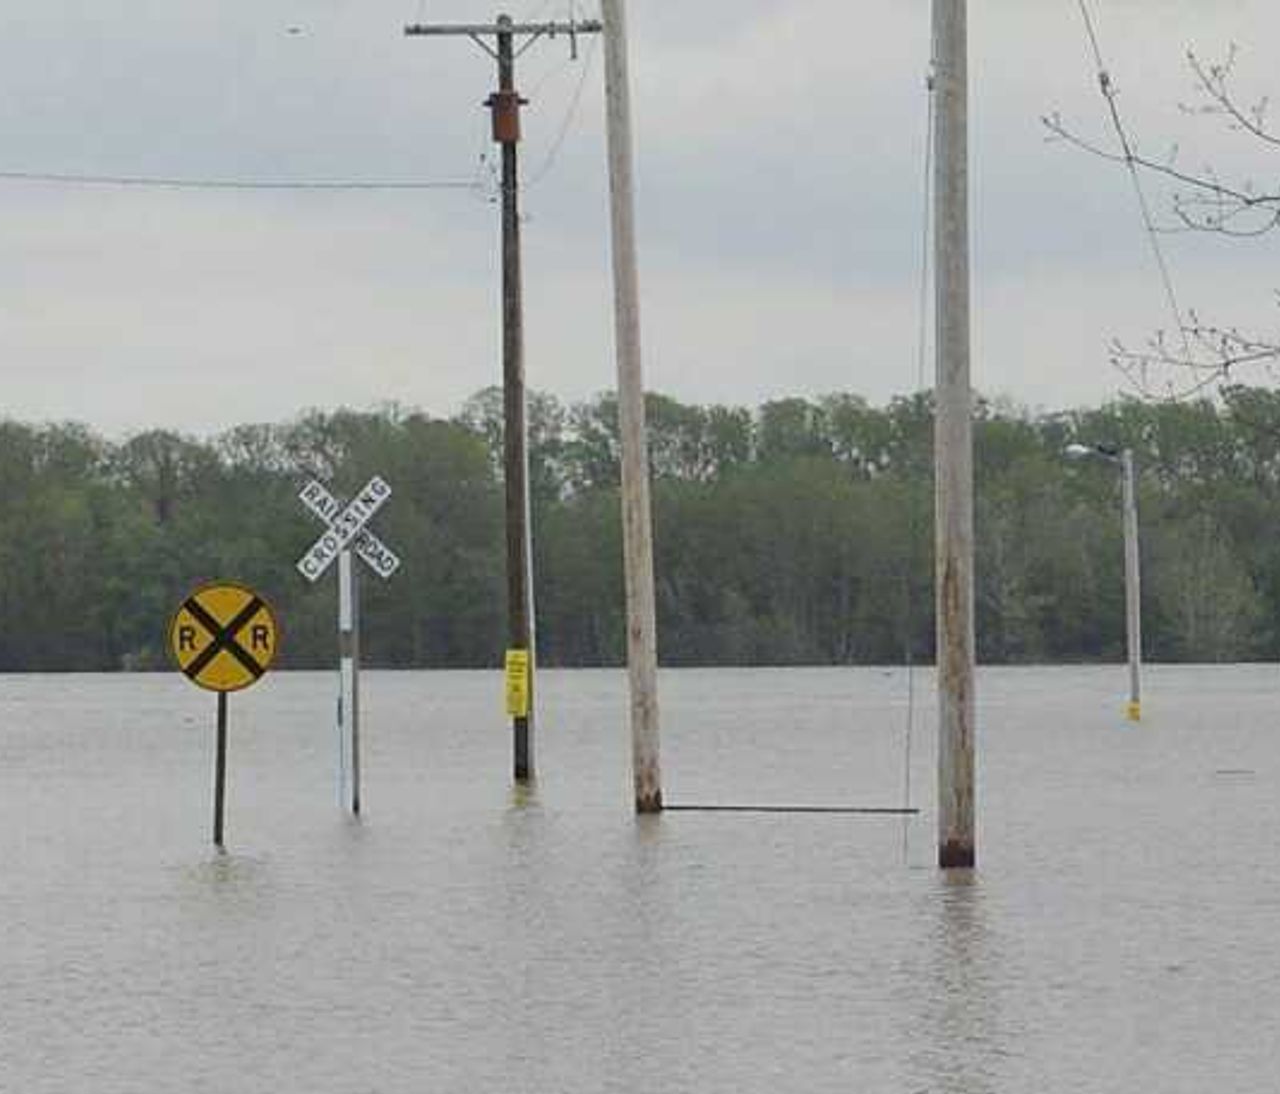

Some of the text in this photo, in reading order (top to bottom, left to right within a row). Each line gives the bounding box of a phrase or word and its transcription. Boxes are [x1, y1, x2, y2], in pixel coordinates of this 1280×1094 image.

[303, 480, 387, 576] CROSSING
[179, 624, 270, 652] R R
